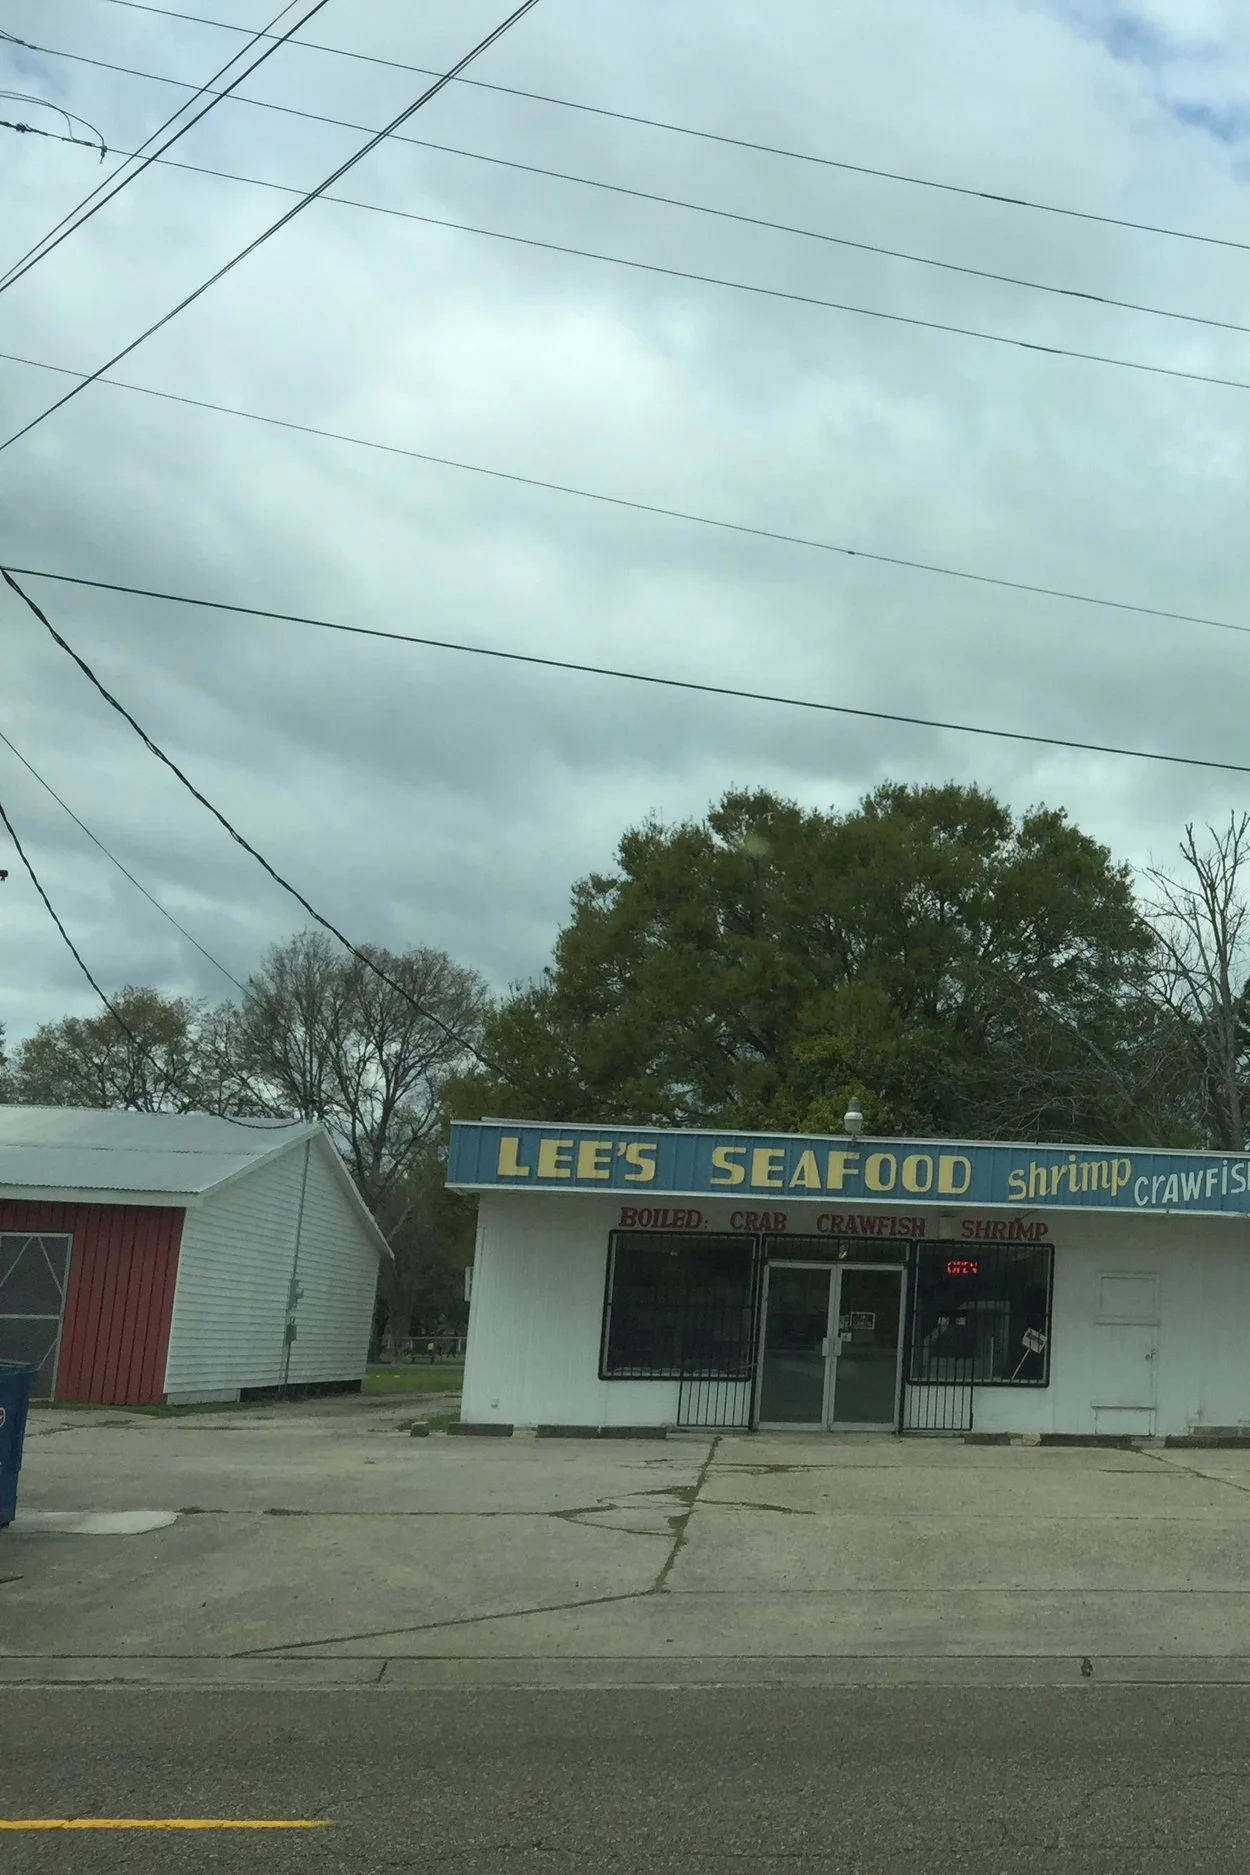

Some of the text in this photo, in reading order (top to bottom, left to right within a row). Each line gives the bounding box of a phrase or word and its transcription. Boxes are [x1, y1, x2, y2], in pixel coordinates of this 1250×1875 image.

[496, 1136, 972, 1193] LEE'S SEAFOOD
[729, 1211, 788, 1232] CRAB
[816, 1213, 927, 1237] CRAWFISH
[961, 1219, 1049, 1242] SHRIMP
[946, 1260, 979, 1275] OPEN
